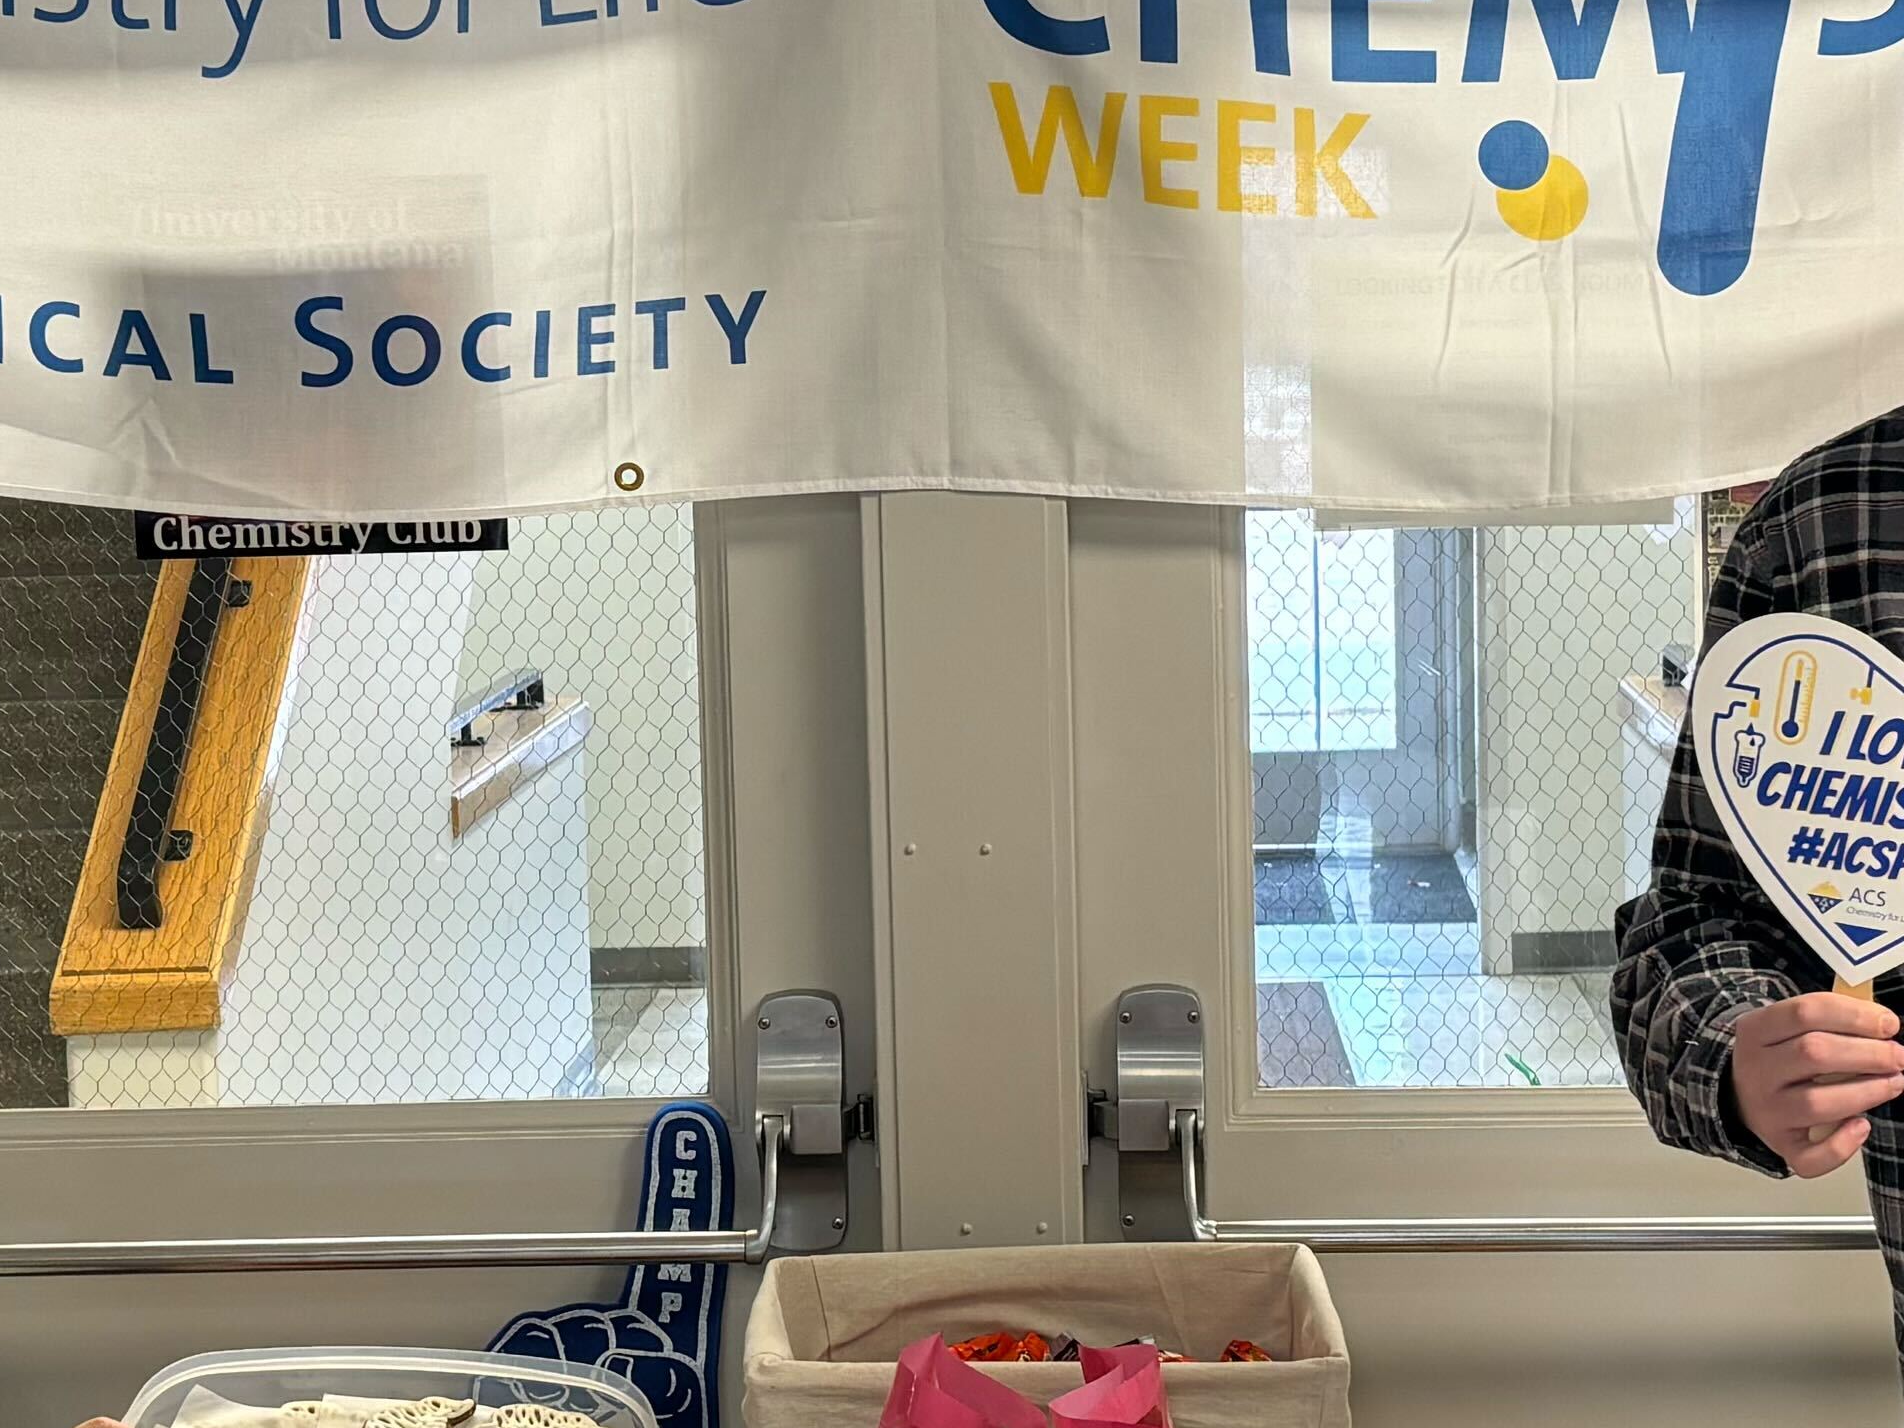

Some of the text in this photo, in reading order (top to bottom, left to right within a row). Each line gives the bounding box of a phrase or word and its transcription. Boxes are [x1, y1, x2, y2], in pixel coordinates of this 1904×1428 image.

[987, 80, 1380, 221] WEEK
[293, 289, 769, 389] SOCIETY
[153, 515, 483, 554] Chemistry Club
[1819, 710, 1845, 756] I
[1848, 887, 1887, 907] ACS
